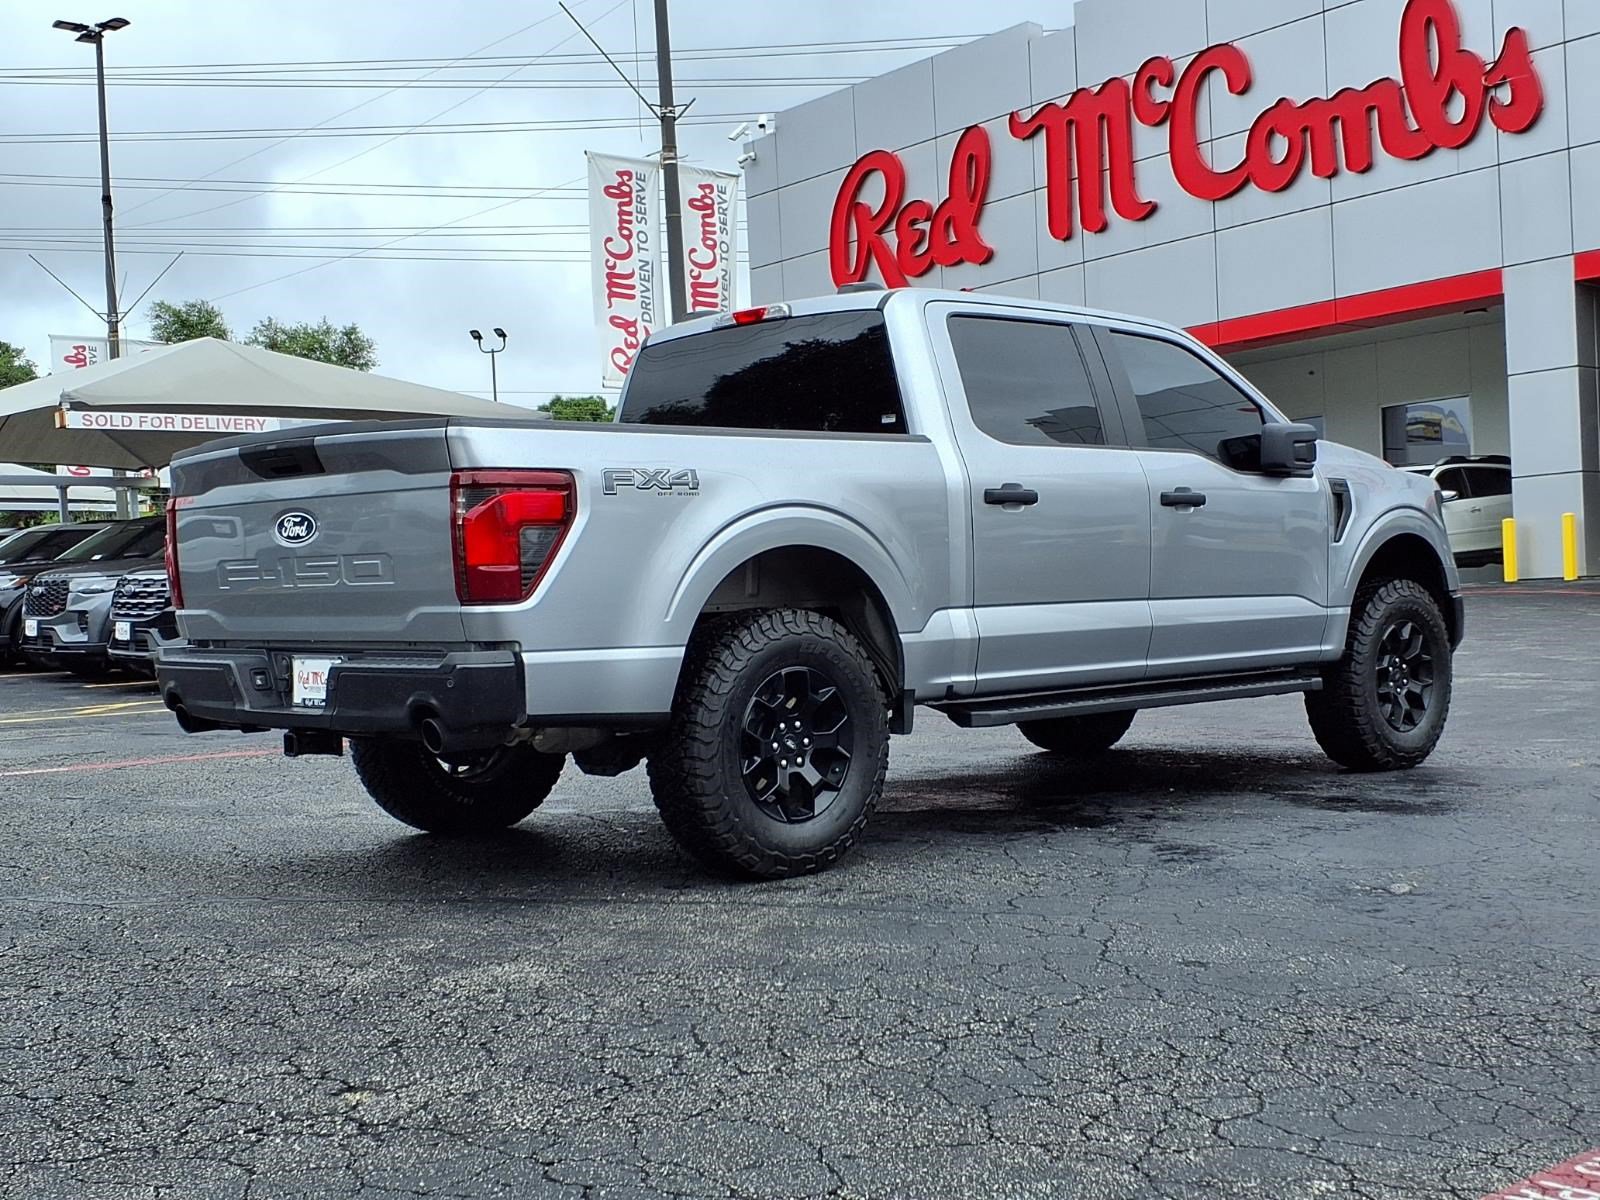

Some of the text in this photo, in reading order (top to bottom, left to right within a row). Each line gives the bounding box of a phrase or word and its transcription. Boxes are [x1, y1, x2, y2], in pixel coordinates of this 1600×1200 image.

[829, 0, 1544, 291] Red McCombs
[716, 184, 728, 236] SERVE
[635, 170, 653, 324] DRIVEN TO SERVE
[719, 241, 729, 263] TO
[604, 169, 640, 375] Red McCombs
[82, 414, 267, 431] SOLD FOR DELIVERY
[601, 467, 699, 496] FX4
[281, 516, 308, 538] Ford
[216, 552, 395, 590] F-150
